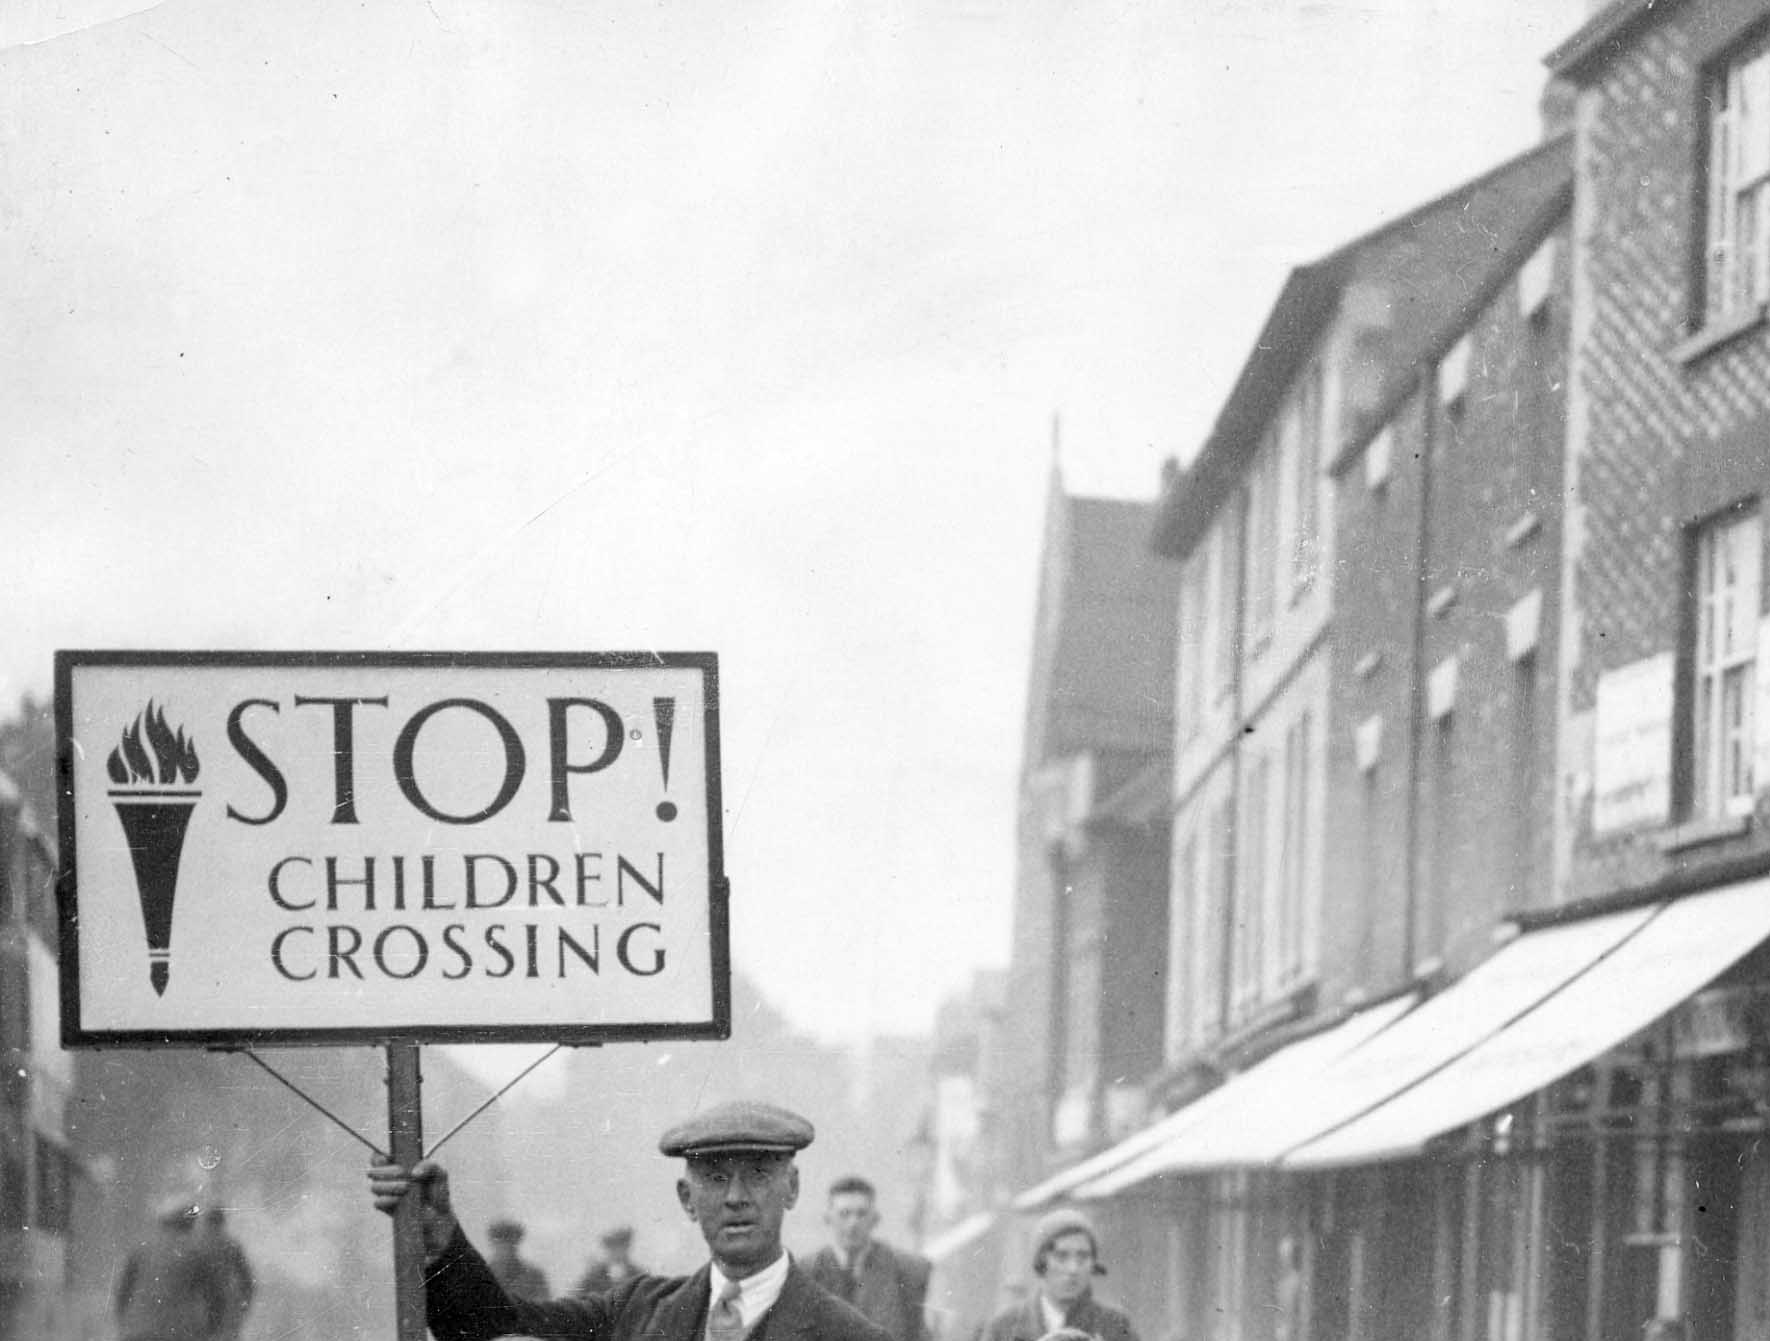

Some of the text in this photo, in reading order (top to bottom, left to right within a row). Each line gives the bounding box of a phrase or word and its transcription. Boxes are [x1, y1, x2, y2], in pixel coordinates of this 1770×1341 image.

[226, 694, 678, 827] STOP!
[267, 851, 666, 912] CHILDREN
[270, 922, 667, 981] CROSSING
